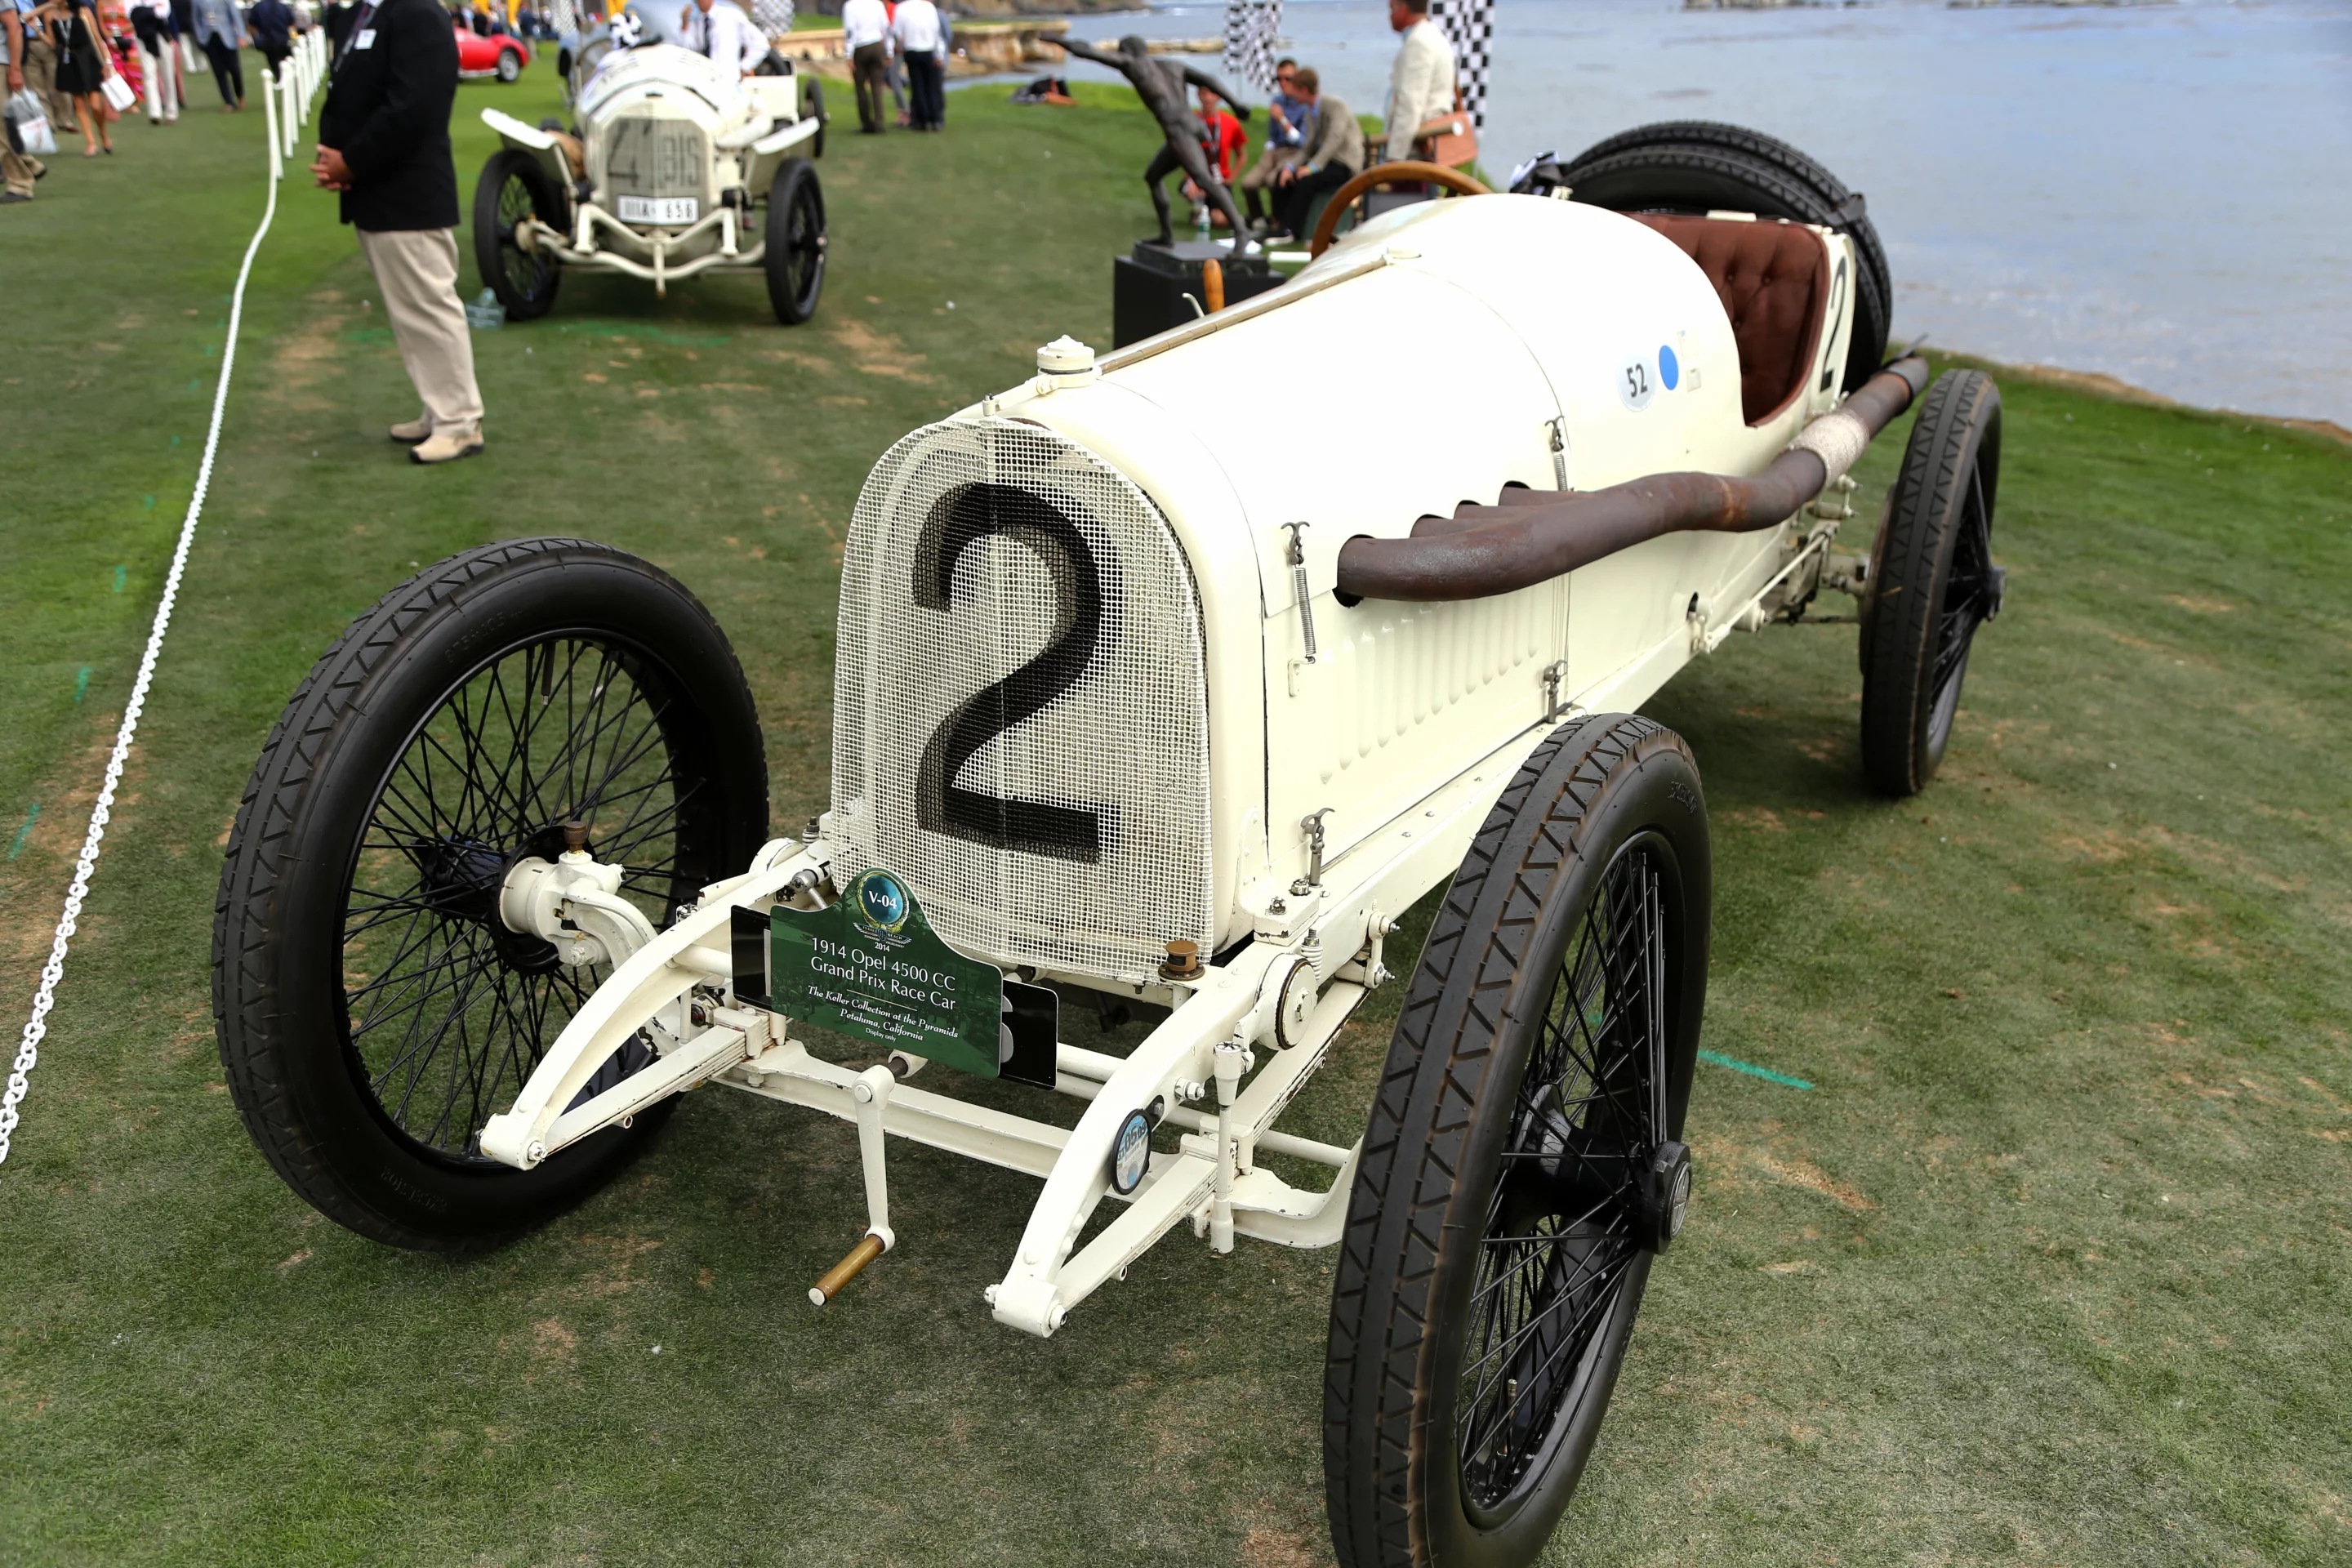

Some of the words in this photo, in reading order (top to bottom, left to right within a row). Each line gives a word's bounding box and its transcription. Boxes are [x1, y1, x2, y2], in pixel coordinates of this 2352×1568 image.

[1820, 256, 1846, 393] 2
[1627, 363, 1648, 399] 52
[913, 480, 1103, 864] 2
[869, 891, 897, 909] V-04
[813, 938, 846, 959] 1914
[851, 949, 886, 970] Opel
[891, 961, 928, 982] 4500
[933, 973, 956, 991] CC
[875, 942, 890, 952] 2014
[811, 956, 853, 980] Grand
[859, 969, 886, 990] Prix
[891, 979, 925, 1001] Race
[930, 991, 956, 1010] Car
[808, 985, 823, 997] The
[826, 991, 849, 1004] Keller
[851, 999, 891, 1018] Collection
[903, 1013, 916, 1025] the
[918, 1018, 959, 1038] Pyramids
[840, 1009, 880, 1029] Petaluma,
[883, 1022, 924, 1041] California
[866, 1027, 884, 1040] Display
[884, 1035, 897, 1043] only
[1125, 1125, 1137, 1152] 05
[1138, 1120, 1147, 1139] 09
